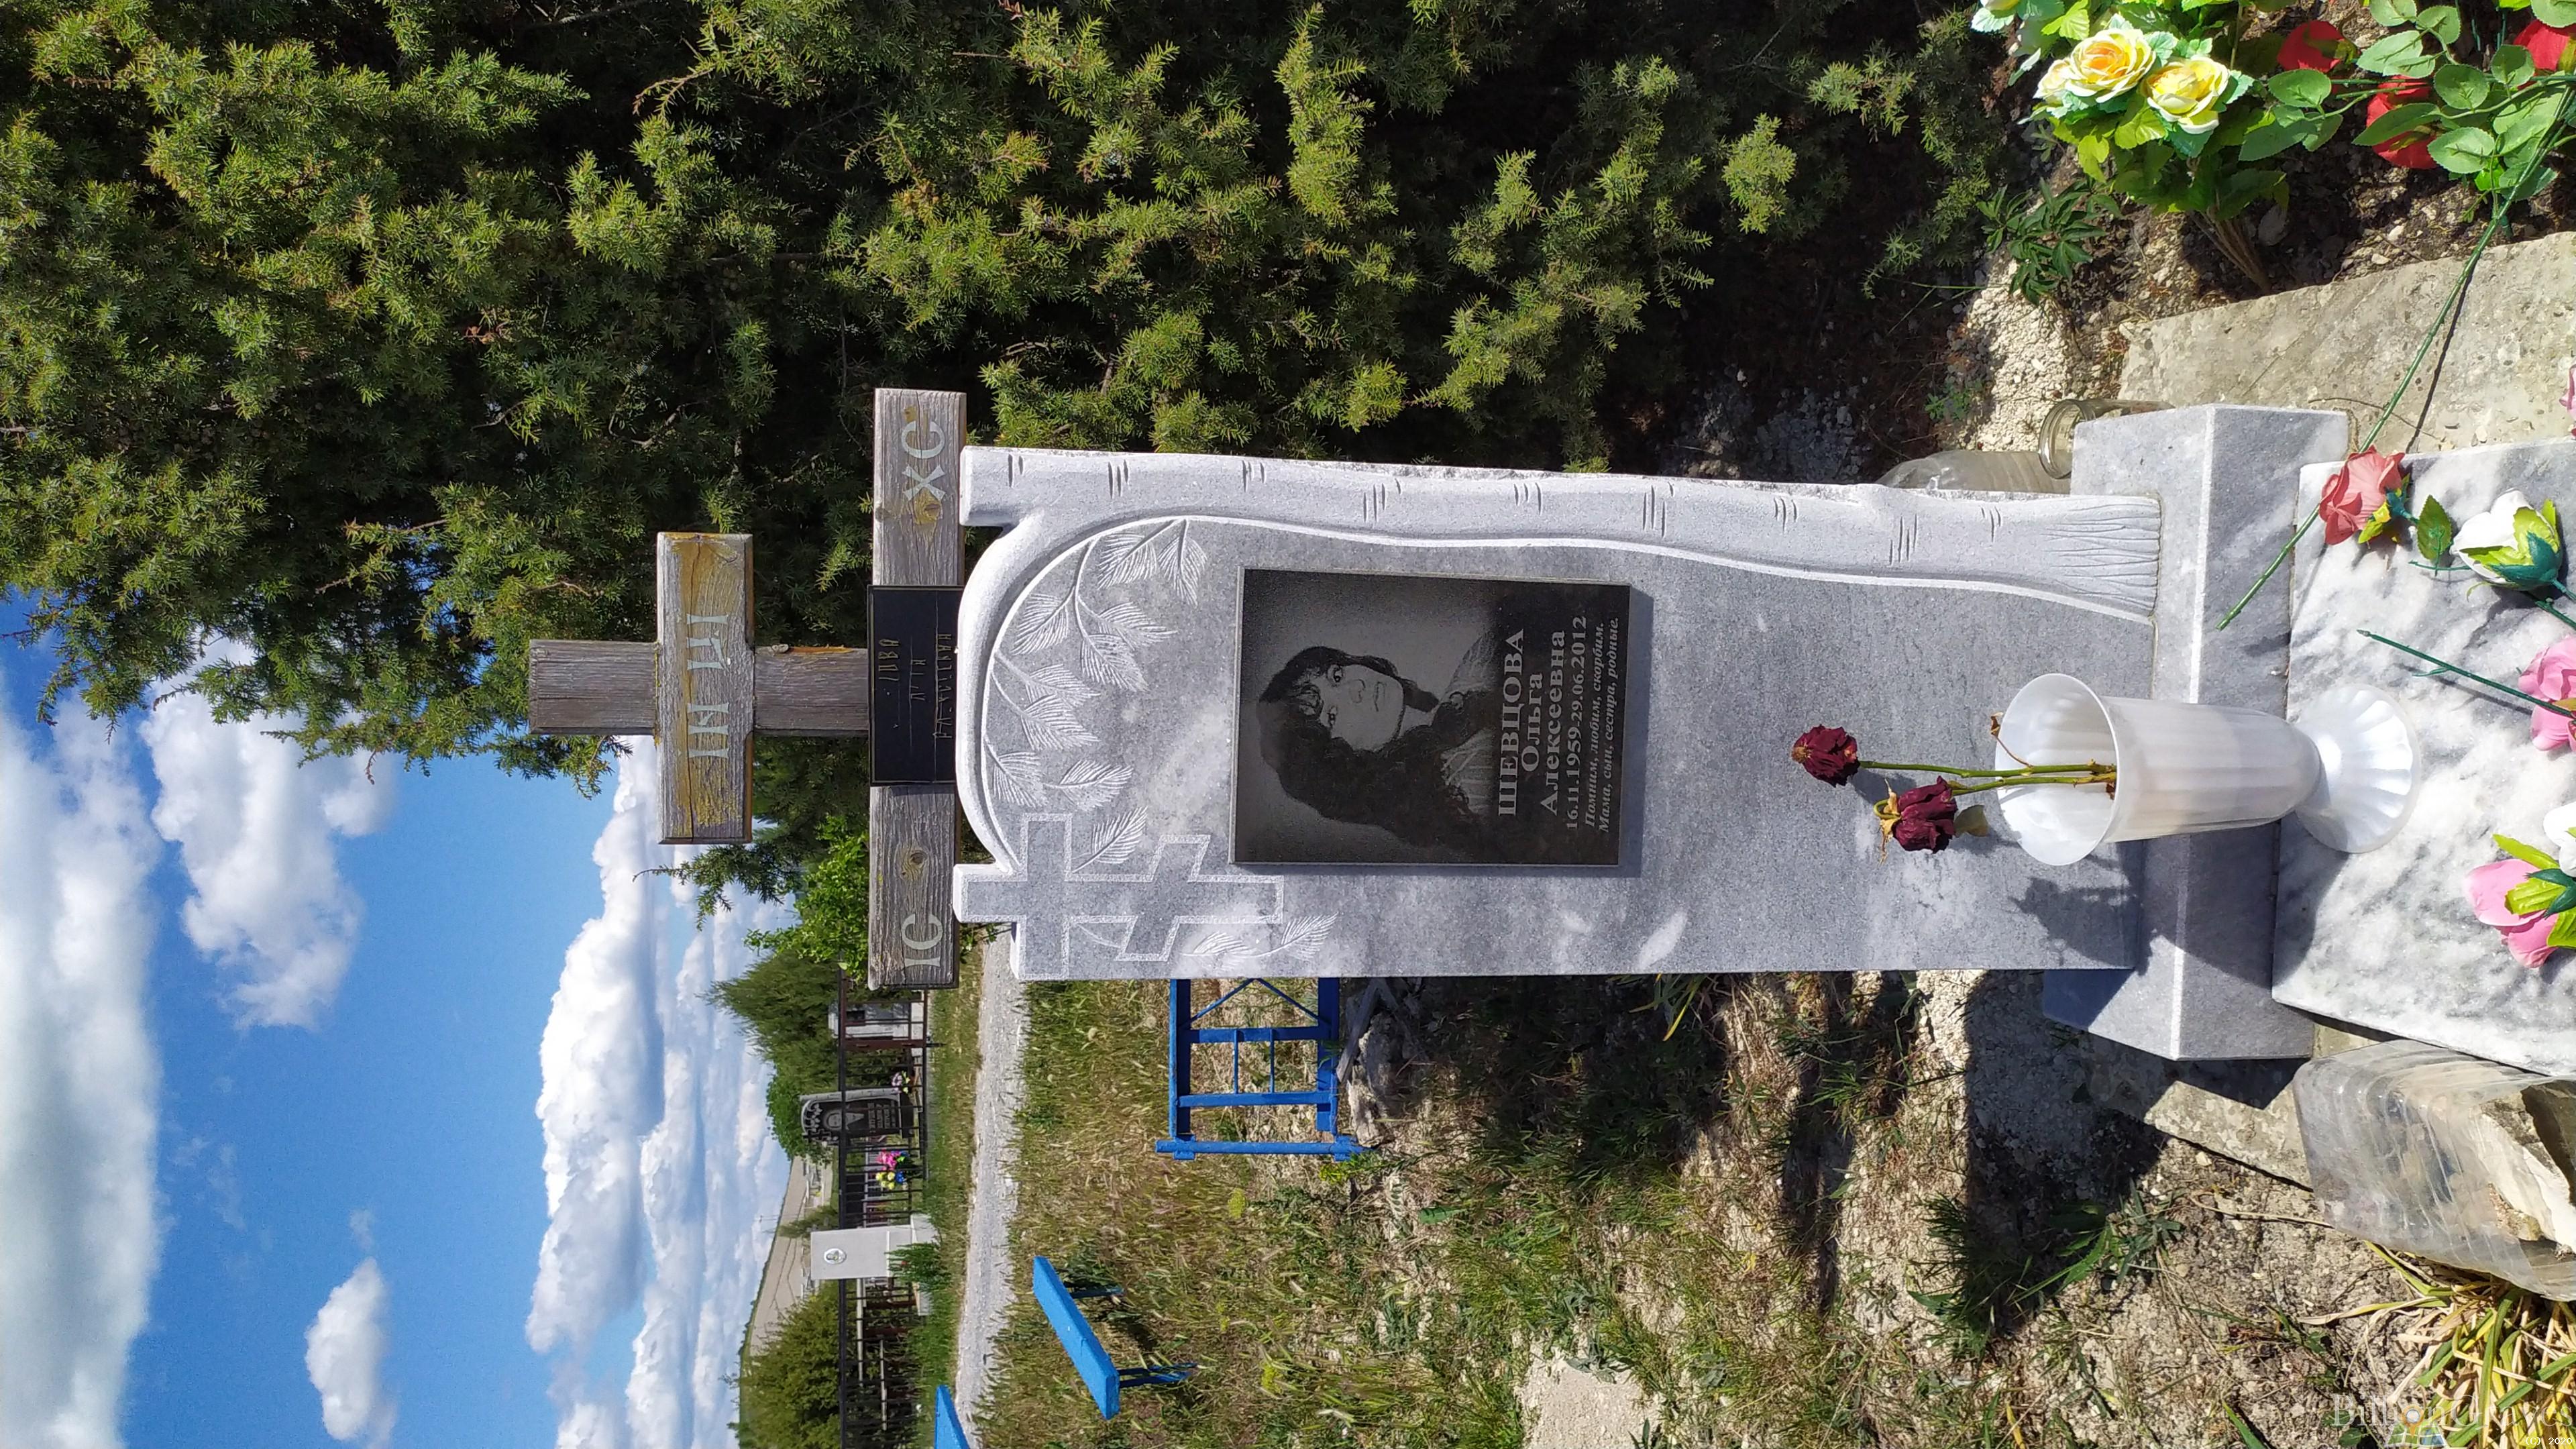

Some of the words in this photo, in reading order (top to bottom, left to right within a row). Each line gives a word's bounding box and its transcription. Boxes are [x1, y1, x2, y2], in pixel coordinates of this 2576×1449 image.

[1591, 621, 1606, 692] скорбим.
[1608, 617, 1621, 678] родные.
[1498, 628, 1524, 816] ШЕВЦОВА
[1520, 672, 1544, 772] Ольга
[1540, 630, 1566, 816] Алексеевна
[1566, 615, 1587, 830] 16.11.1959-29.06.2012
[1589, 696, 1603, 756] любим,
[1604, 680, 1619, 742] сестра,
[1585, 752, 1601, 827] Помним,
[1603, 745, 1616, 779] сын,
[1599, 782, 1613, 833] Мама,
